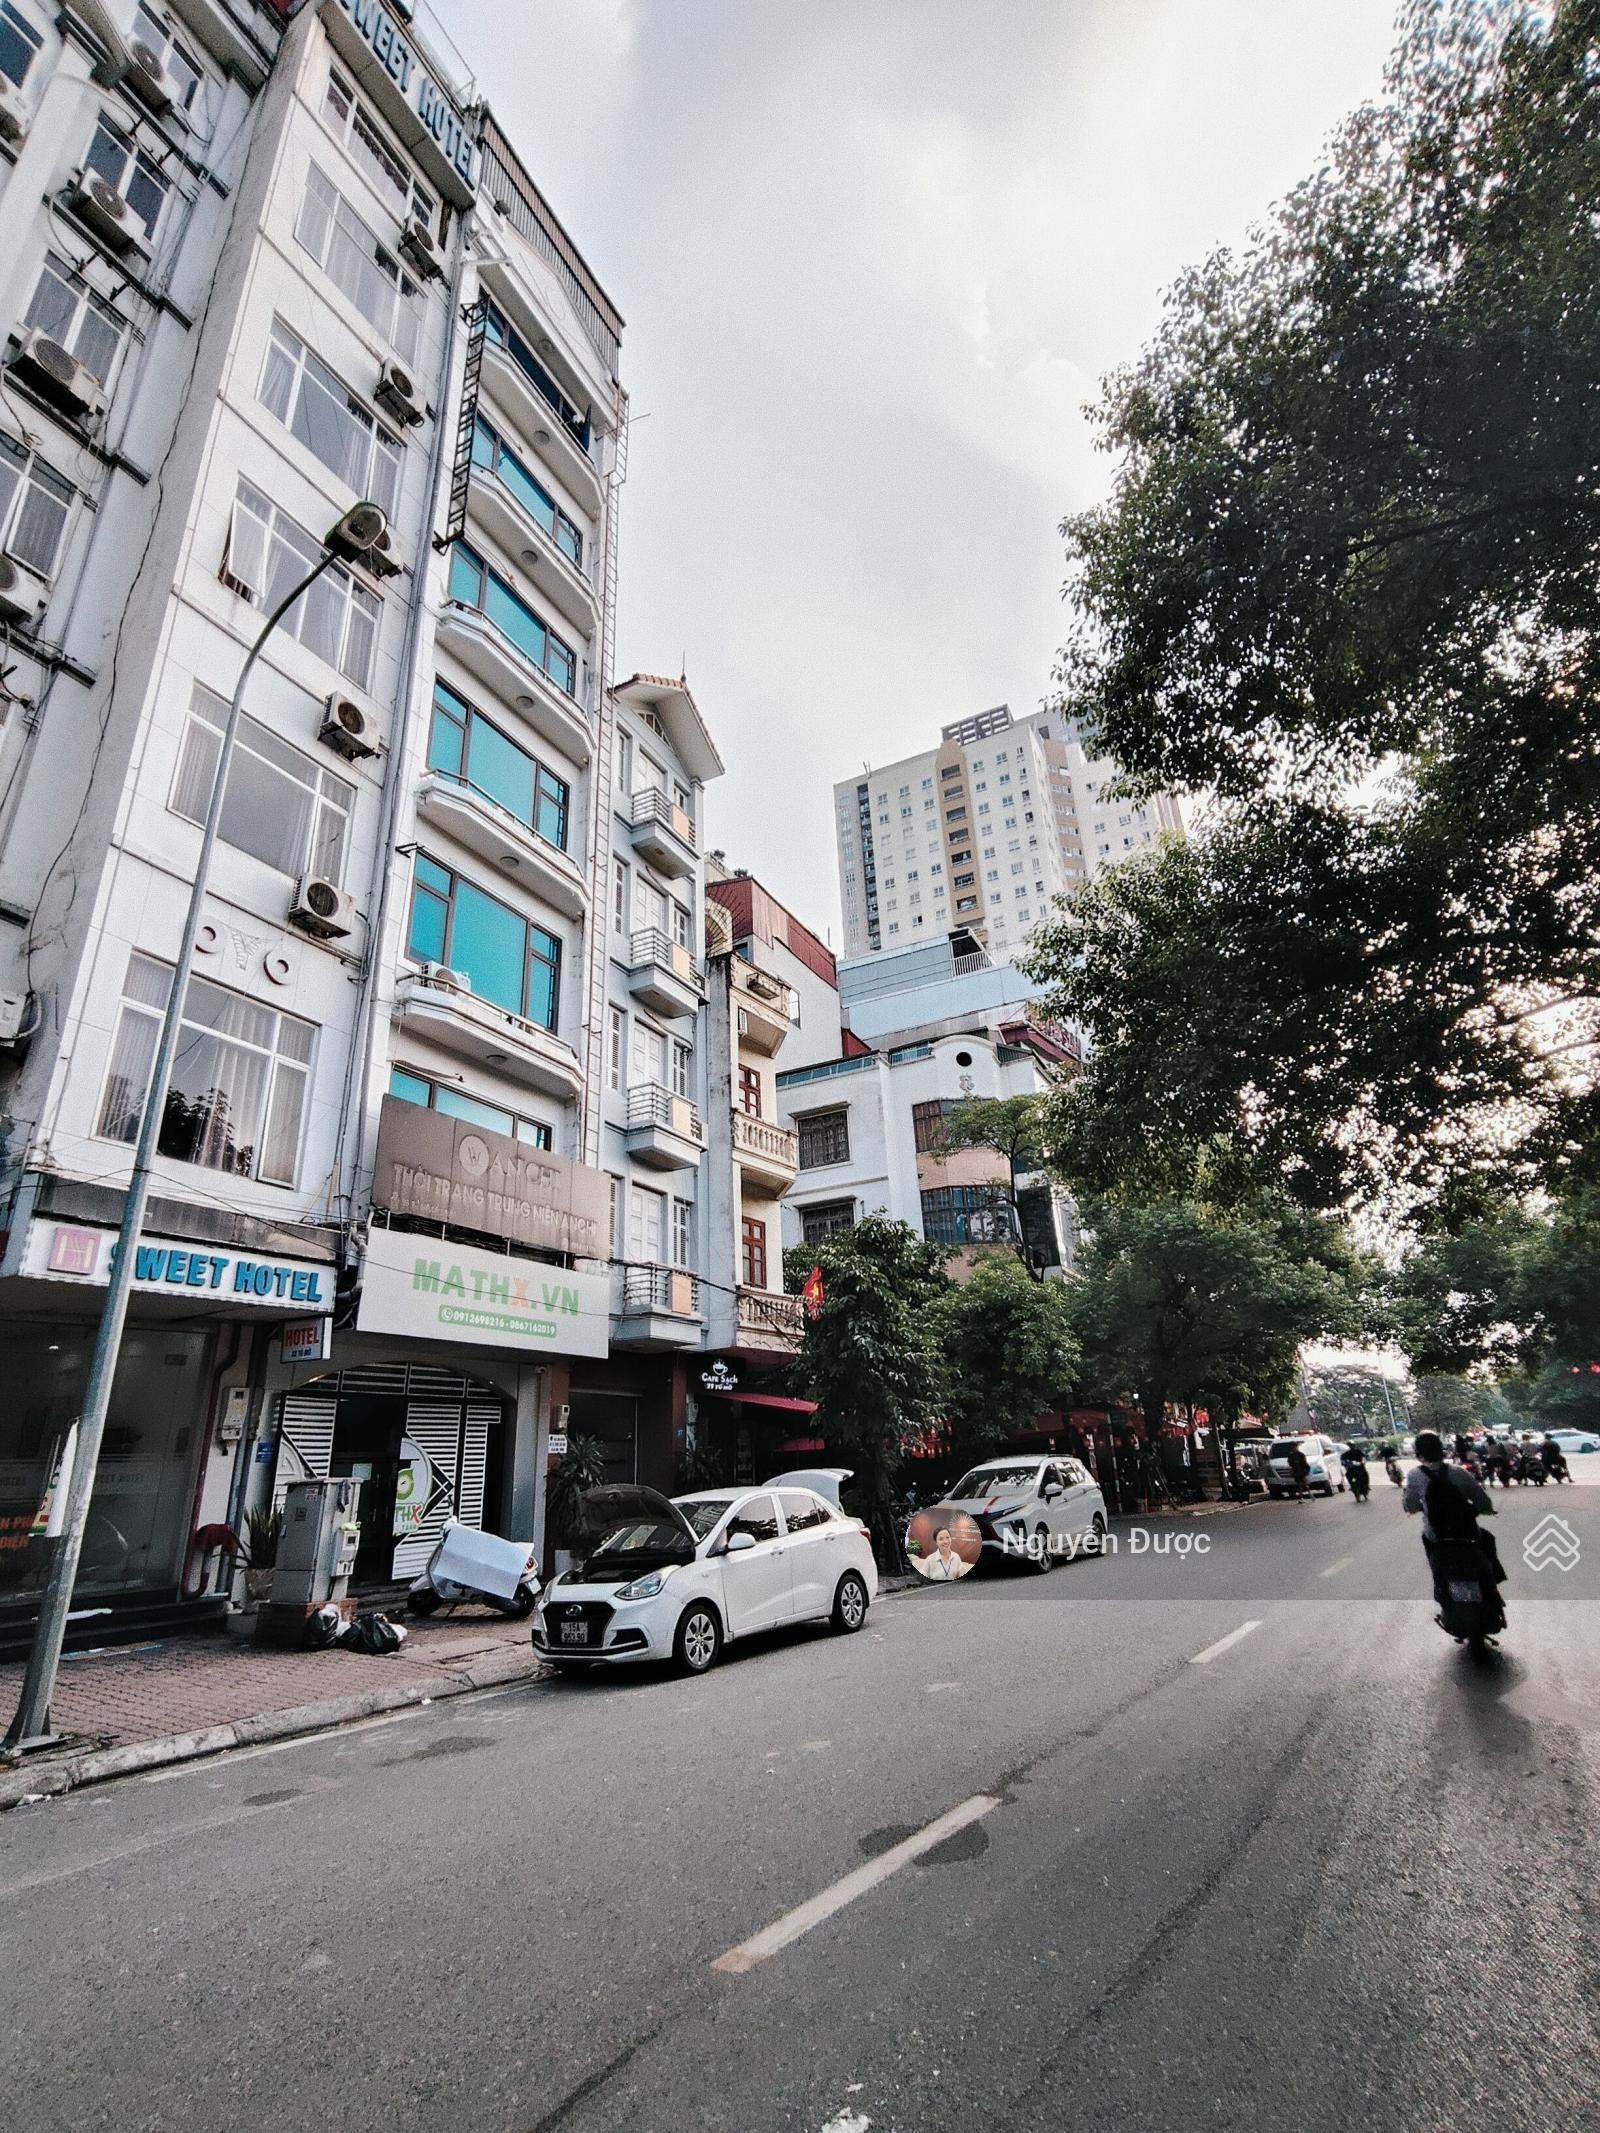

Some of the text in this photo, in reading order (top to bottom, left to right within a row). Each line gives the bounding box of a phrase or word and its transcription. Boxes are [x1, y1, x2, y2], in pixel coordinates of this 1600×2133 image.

[341, 0, 476, 191] WEET HOTEL
[435, 1176, 484, 1204] TRANG
[561, 1213, 597, 1235] ANCHI
[234, 1260, 322, 1303] HOTEL
[412, 1258, 579, 1316] MATHX.VN
[286, 1327, 320, 1347] HOTEL
